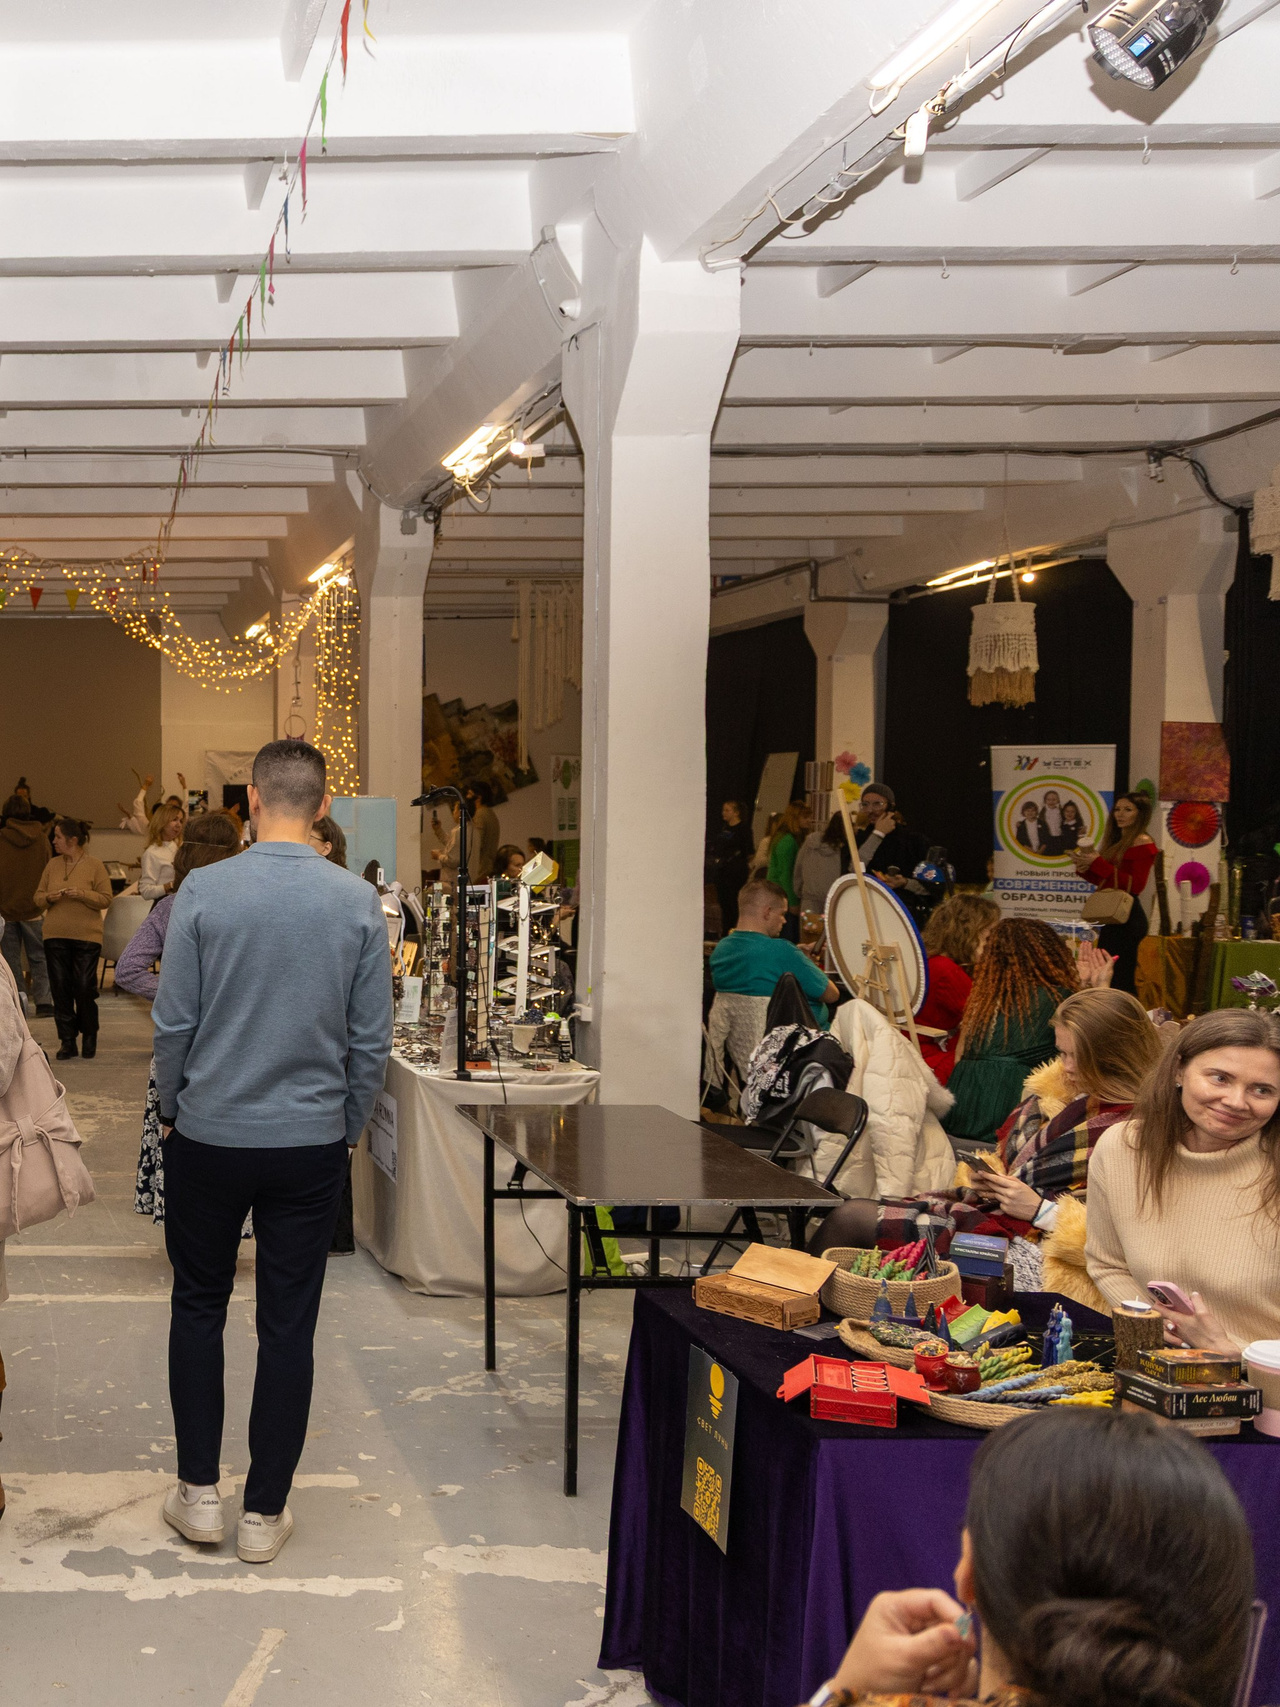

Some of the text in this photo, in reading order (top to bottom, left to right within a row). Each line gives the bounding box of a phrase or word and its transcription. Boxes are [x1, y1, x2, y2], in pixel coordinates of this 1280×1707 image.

[1016, 869, 1050, 877] НОВЫЙ
[996, 880, 1095, 891] СОВРЕМЕННОГ
[1001, 892, 1087, 903] ОБРАЗОВАН
[1192, 1394, 1208, 1404] Лес
[1208, 1393, 1237, 1403] Любви
[696, 1416, 713, 1435] СВЕТ
[243, 1519, 262, 1527] adidas
